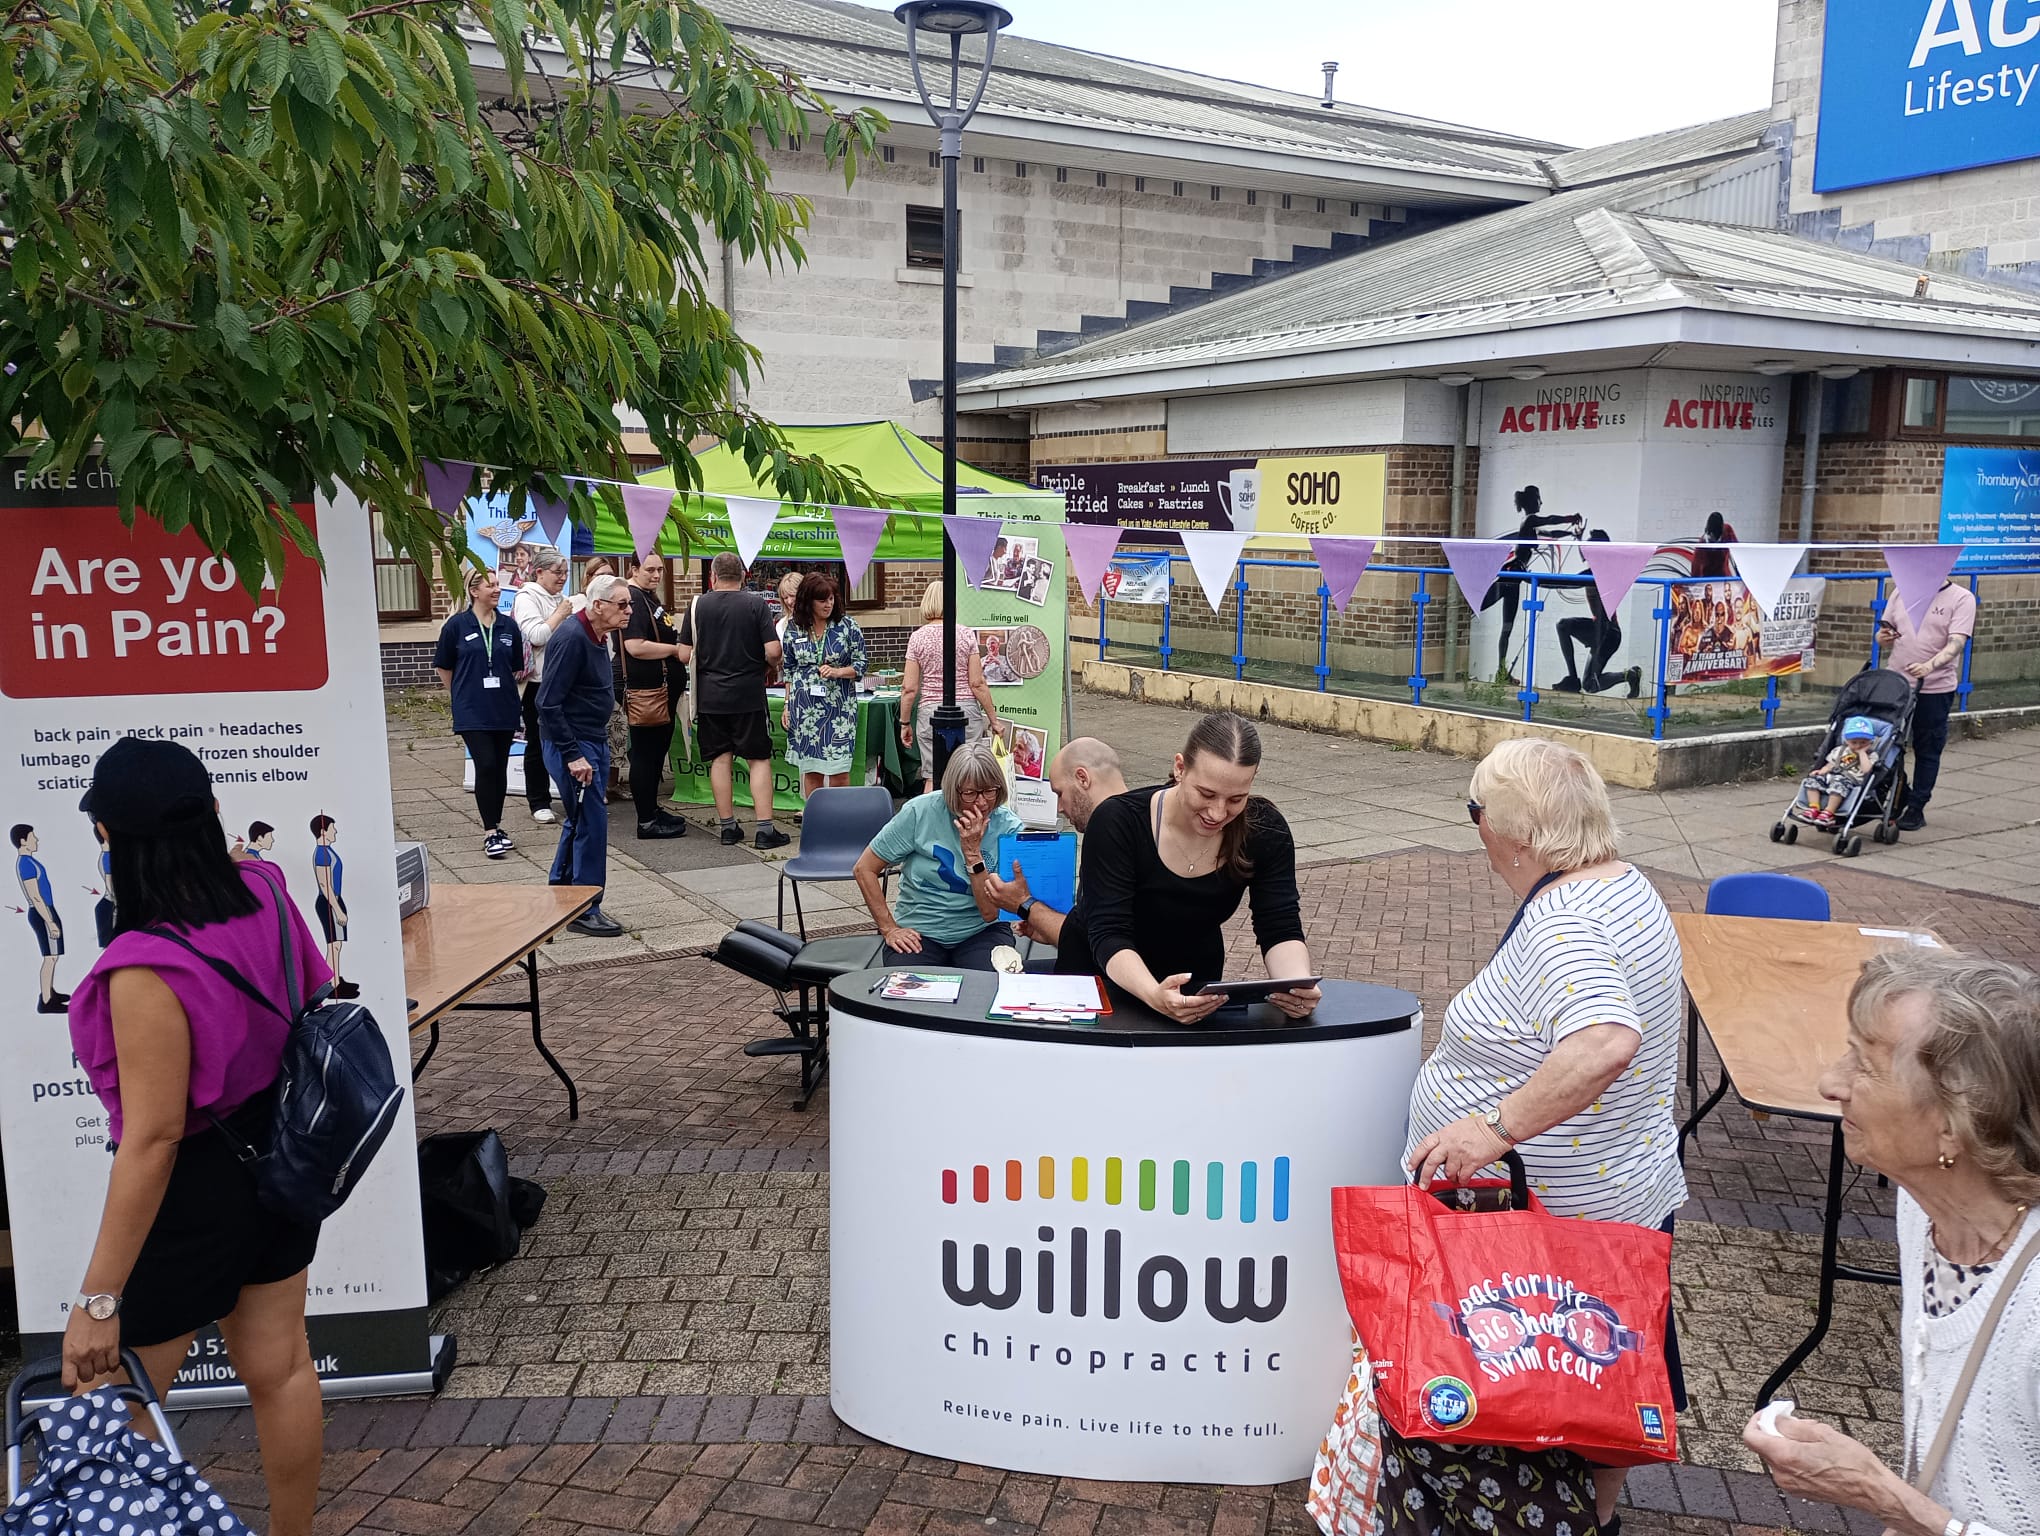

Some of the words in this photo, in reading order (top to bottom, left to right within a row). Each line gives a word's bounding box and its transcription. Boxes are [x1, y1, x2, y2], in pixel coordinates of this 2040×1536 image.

[1904, 63, 2040, 117] Lifesty
[1537, 383, 1621, 406] INSPIRING
[1700, 383, 1771, 404] INSPIRING
[1499, 401, 1600, 433] ACTIVE
[1663, 399, 1755, 430] ACTIVE
[14, 469, 78, 490] FREE
[1041, 473, 1086, 490] Triple
[1117, 481, 1165, 493] Breakfast
[1180, 481, 1210, 493] Lunch
[1286, 471, 1341, 506] SOHO
[1976, 473, 2021, 490] Thornbury
[1065, 494, 1108, 513] tified
[1117, 498, 1144, 509] Cakes
[1158, 498, 1204, 510] Pastries
[697, 526, 729, 539] outh
[767, 526, 840, 541] cestershir
[1290, 512, 1320, 535] COFFEE
[760, 542, 793, 552] ncil
[30, 547, 141, 596] Are
[1013, 614, 1029, 623] well
[31, 612, 89, 660] in
[110, 606, 286, 658] Pain?
[1682, 657, 1747, 675] ANNIVERSARY
[999, 705, 1037, 715] dementia
[34, 727, 75, 743] back
[76, 727, 111, 744] pain
[127, 725, 164, 740] neck
[169, 724, 203, 741] pain
[219, 721, 303, 736] headaches
[21, 752, 91, 768] lumbago
[197, 747, 248, 762] frozen
[252, 744, 321, 760] shoulder
[209, 772, 257, 785] tennis
[262, 769, 308, 782] elbow
[774, 773, 800, 794] Da
[75, 1116, 101, 1128] Get
[75, 1134, 105, 1148] plus
[942, 1225, 1288, 1324] willow
[307, 1286, 334, 1296] the
[344, 1282, 382, 1294] full.
[1582, 1327, 1595, 1351] &
[944, 1332, 1281, 1373] chiropractic
[1431, 1395, 1466, 1409] BETTER
[944, 1400, 1013, 1422] Relieve
[1022, 1412, 1070, 1429] pain.
[1080, 1418, 1119, 1434] Live
[1130, 1420, 1163, 1436] life
[1173, 1423, 1192, 1437] to
[1202, 1422, 1234, 1438] the
[1244, 1422, 1284, 1437] full.
[1645, 1426, 1662, 1435] ALDI
